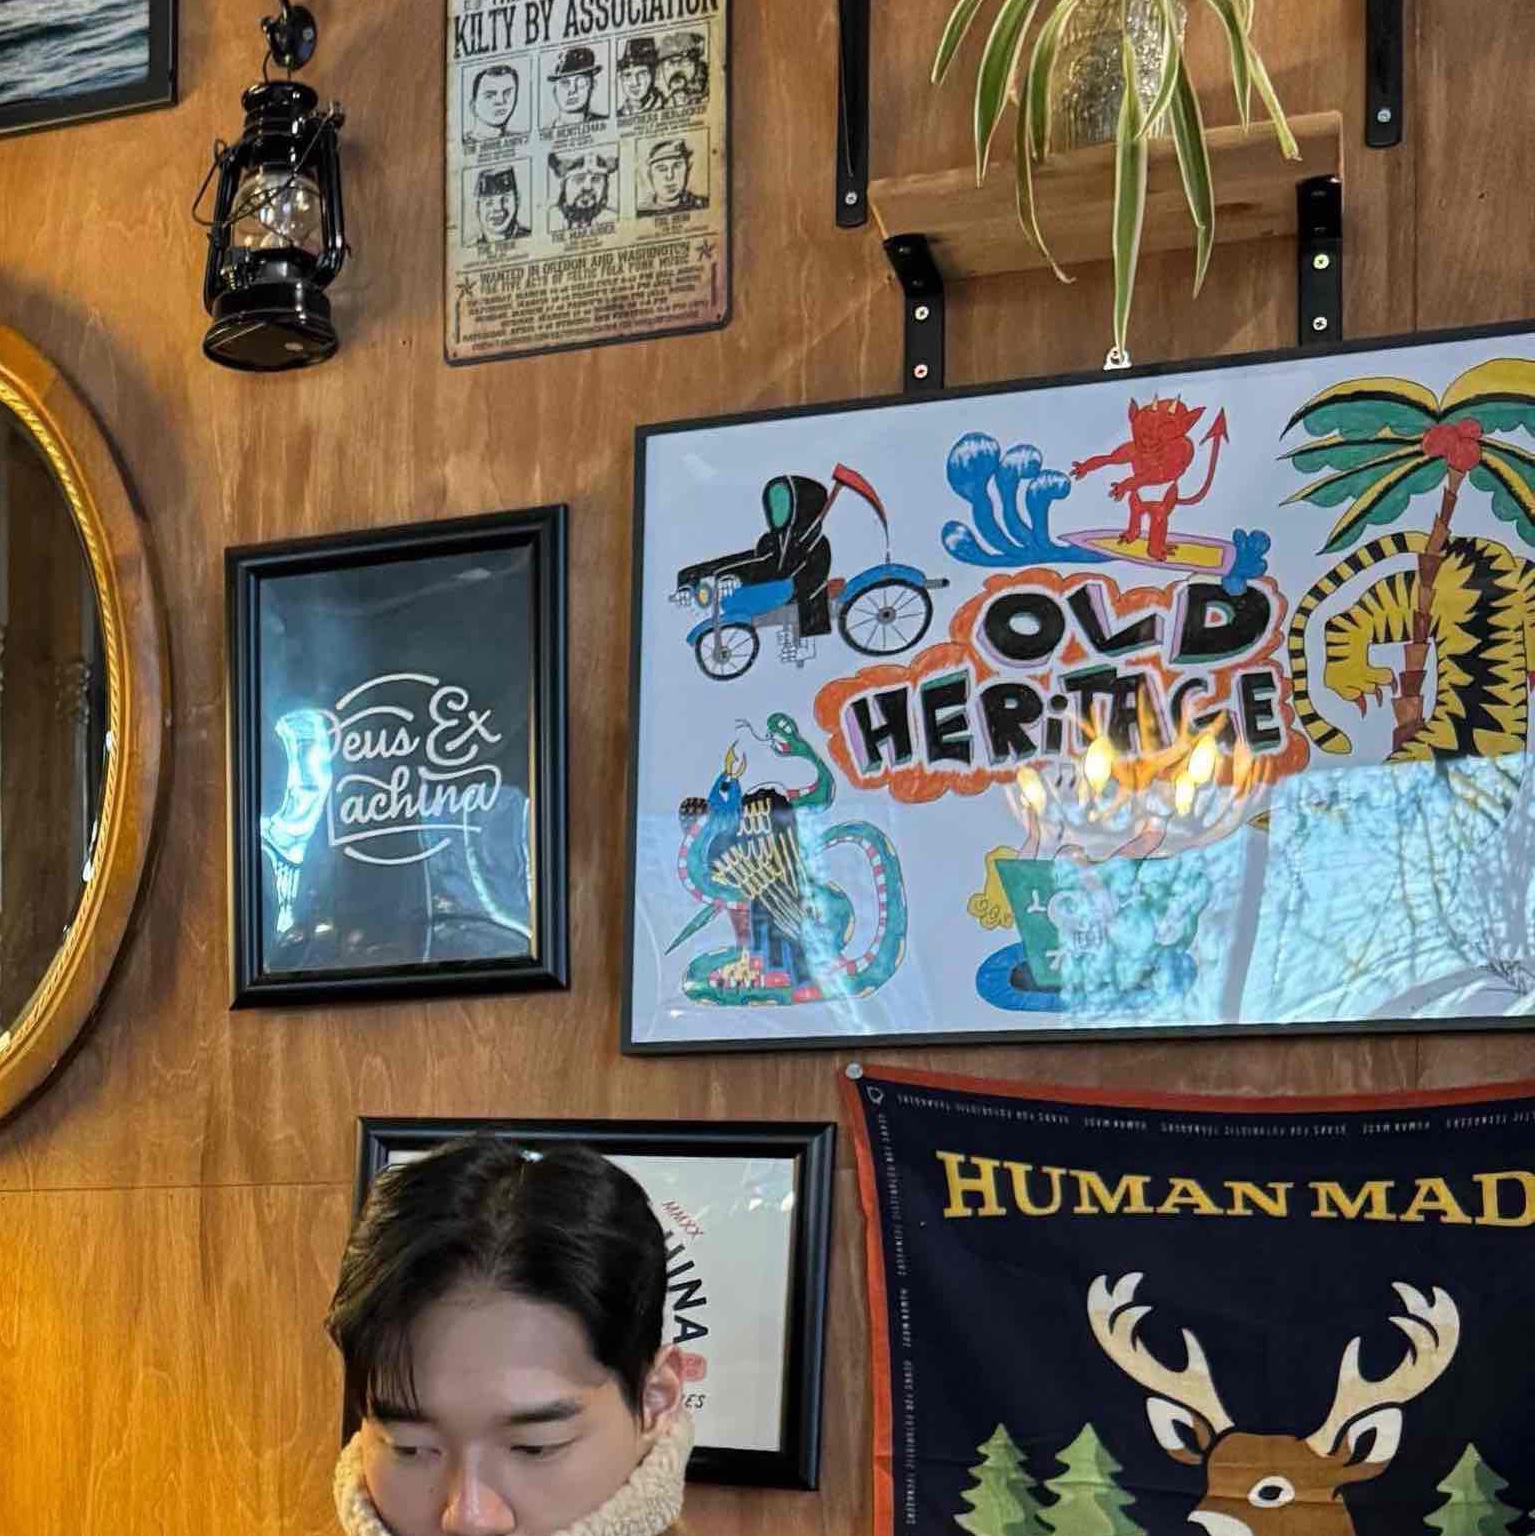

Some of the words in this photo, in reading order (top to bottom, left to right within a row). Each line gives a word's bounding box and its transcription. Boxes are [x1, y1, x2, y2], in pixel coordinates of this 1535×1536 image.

[454, 5, 517, 58] KILTY
[525, 0, 553, 45] BY
[563, 0, 719, 38] ASSOCIA
[977, 582, 1272, 668] OLD
[426, 686, 502, 766] Ex
[326, 765, 501, 825] achina
[936, 1150, 1294, 1218] HUMAN
